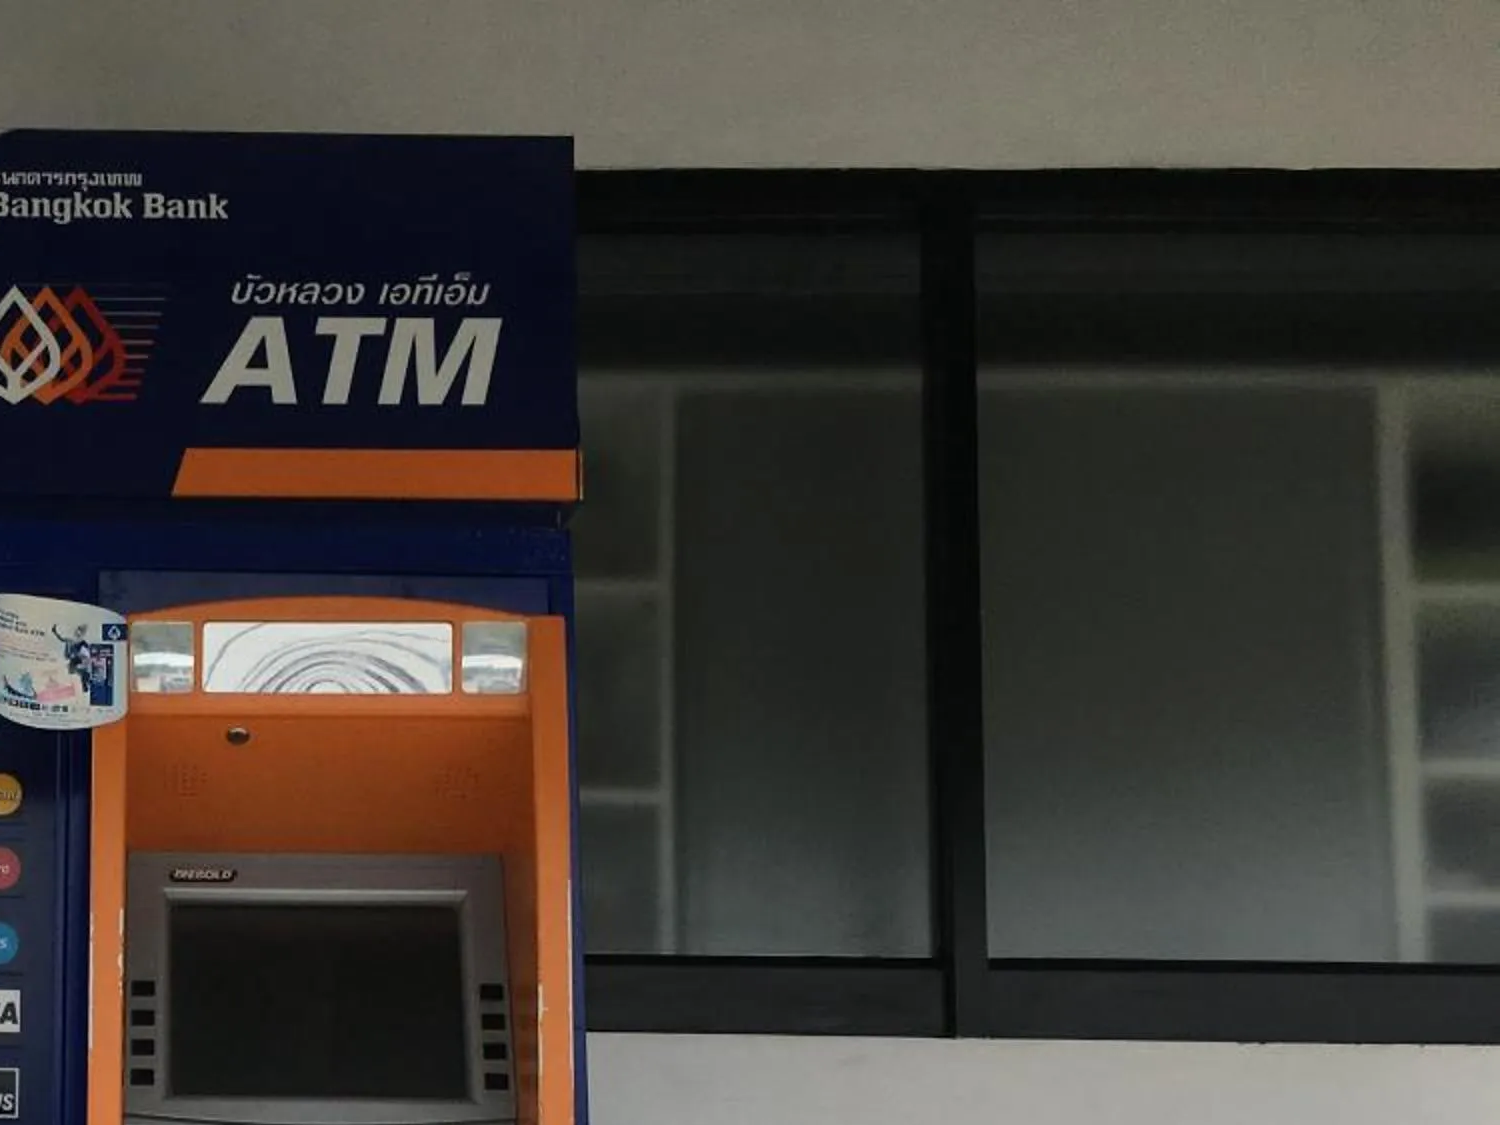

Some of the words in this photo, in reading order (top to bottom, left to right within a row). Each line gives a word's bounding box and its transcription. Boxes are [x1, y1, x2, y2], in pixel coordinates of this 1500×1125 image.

[142, 192, 230, 220] Bank
[230, 273, 367, 305] บัวหลวง
[377, 271, 492, 305] เอทีเอ็ม
[200, 315, 504, 405] ATM
